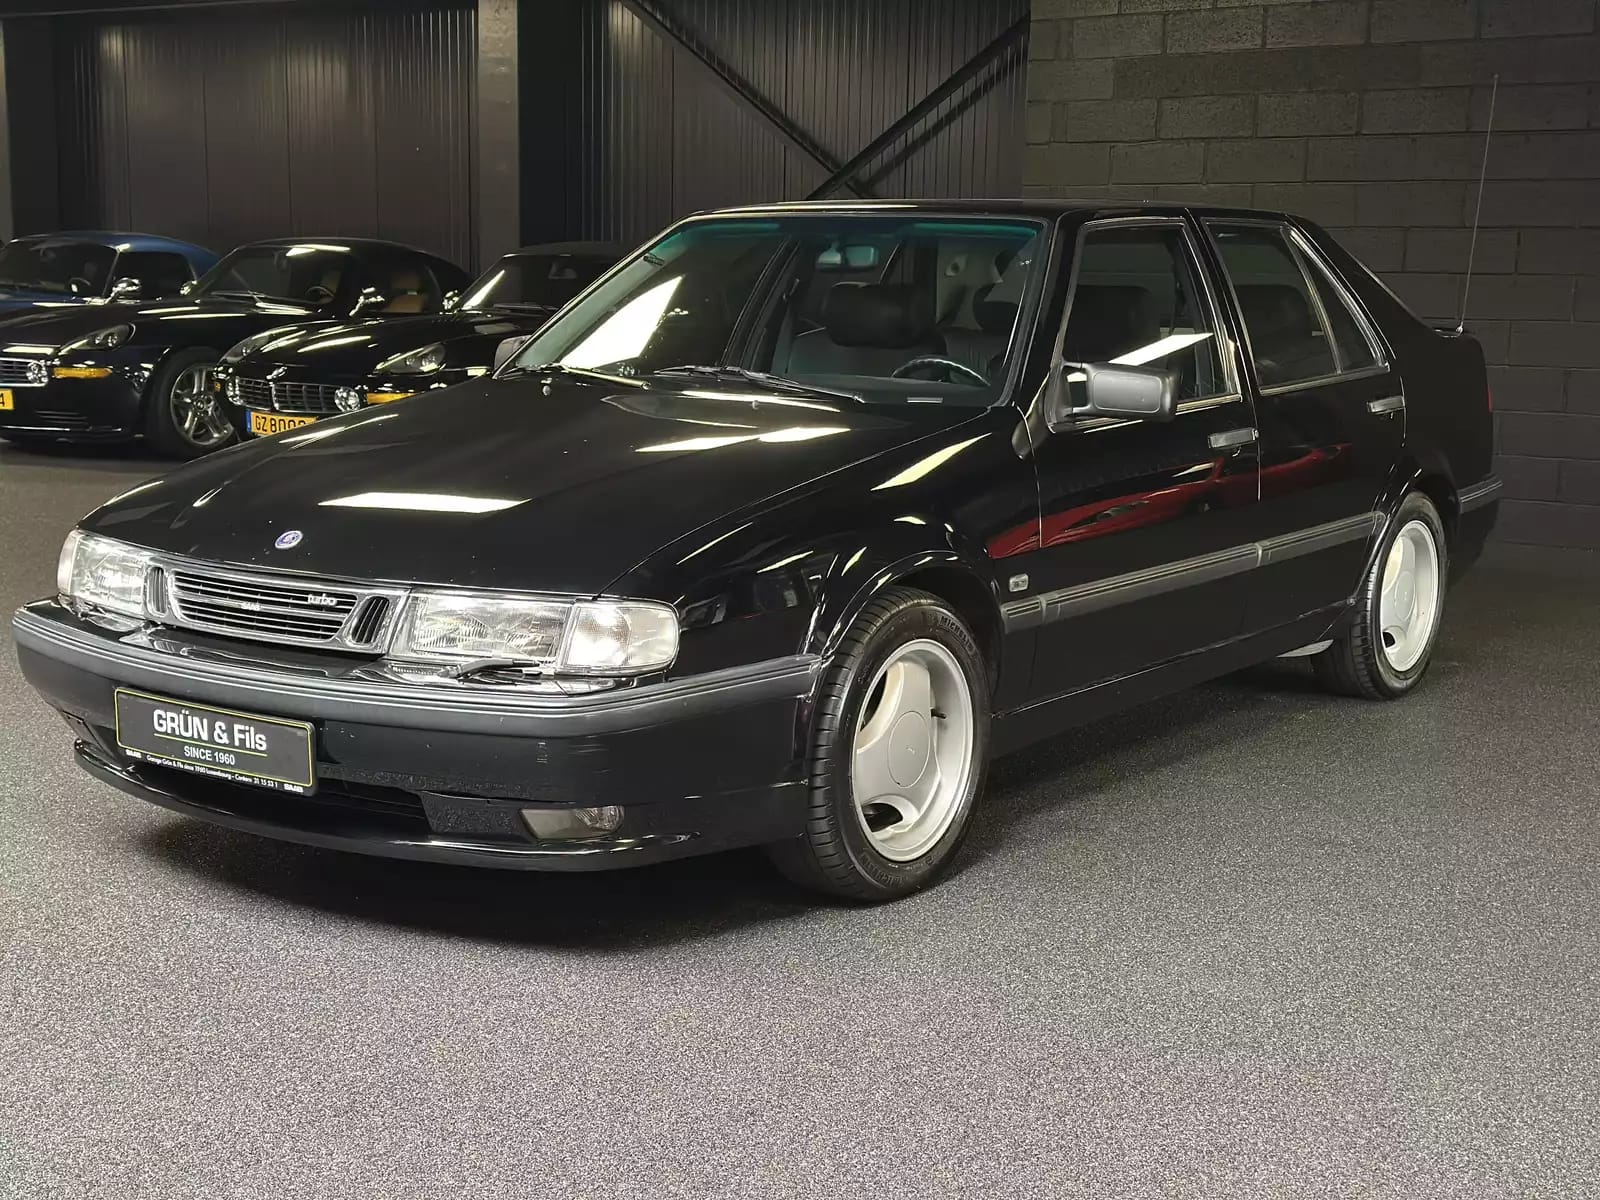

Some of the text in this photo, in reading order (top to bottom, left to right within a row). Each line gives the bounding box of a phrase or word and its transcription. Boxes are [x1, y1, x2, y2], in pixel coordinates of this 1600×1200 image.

[255, 415, 267, 432] GZ
[307, 593, 337, 606] turbo
[937, 614, 975, 654] MICHELIN
[153, 708, 267, 751] GRÜN & Fils
[184, 745, 236, 766] SINCE 1960
